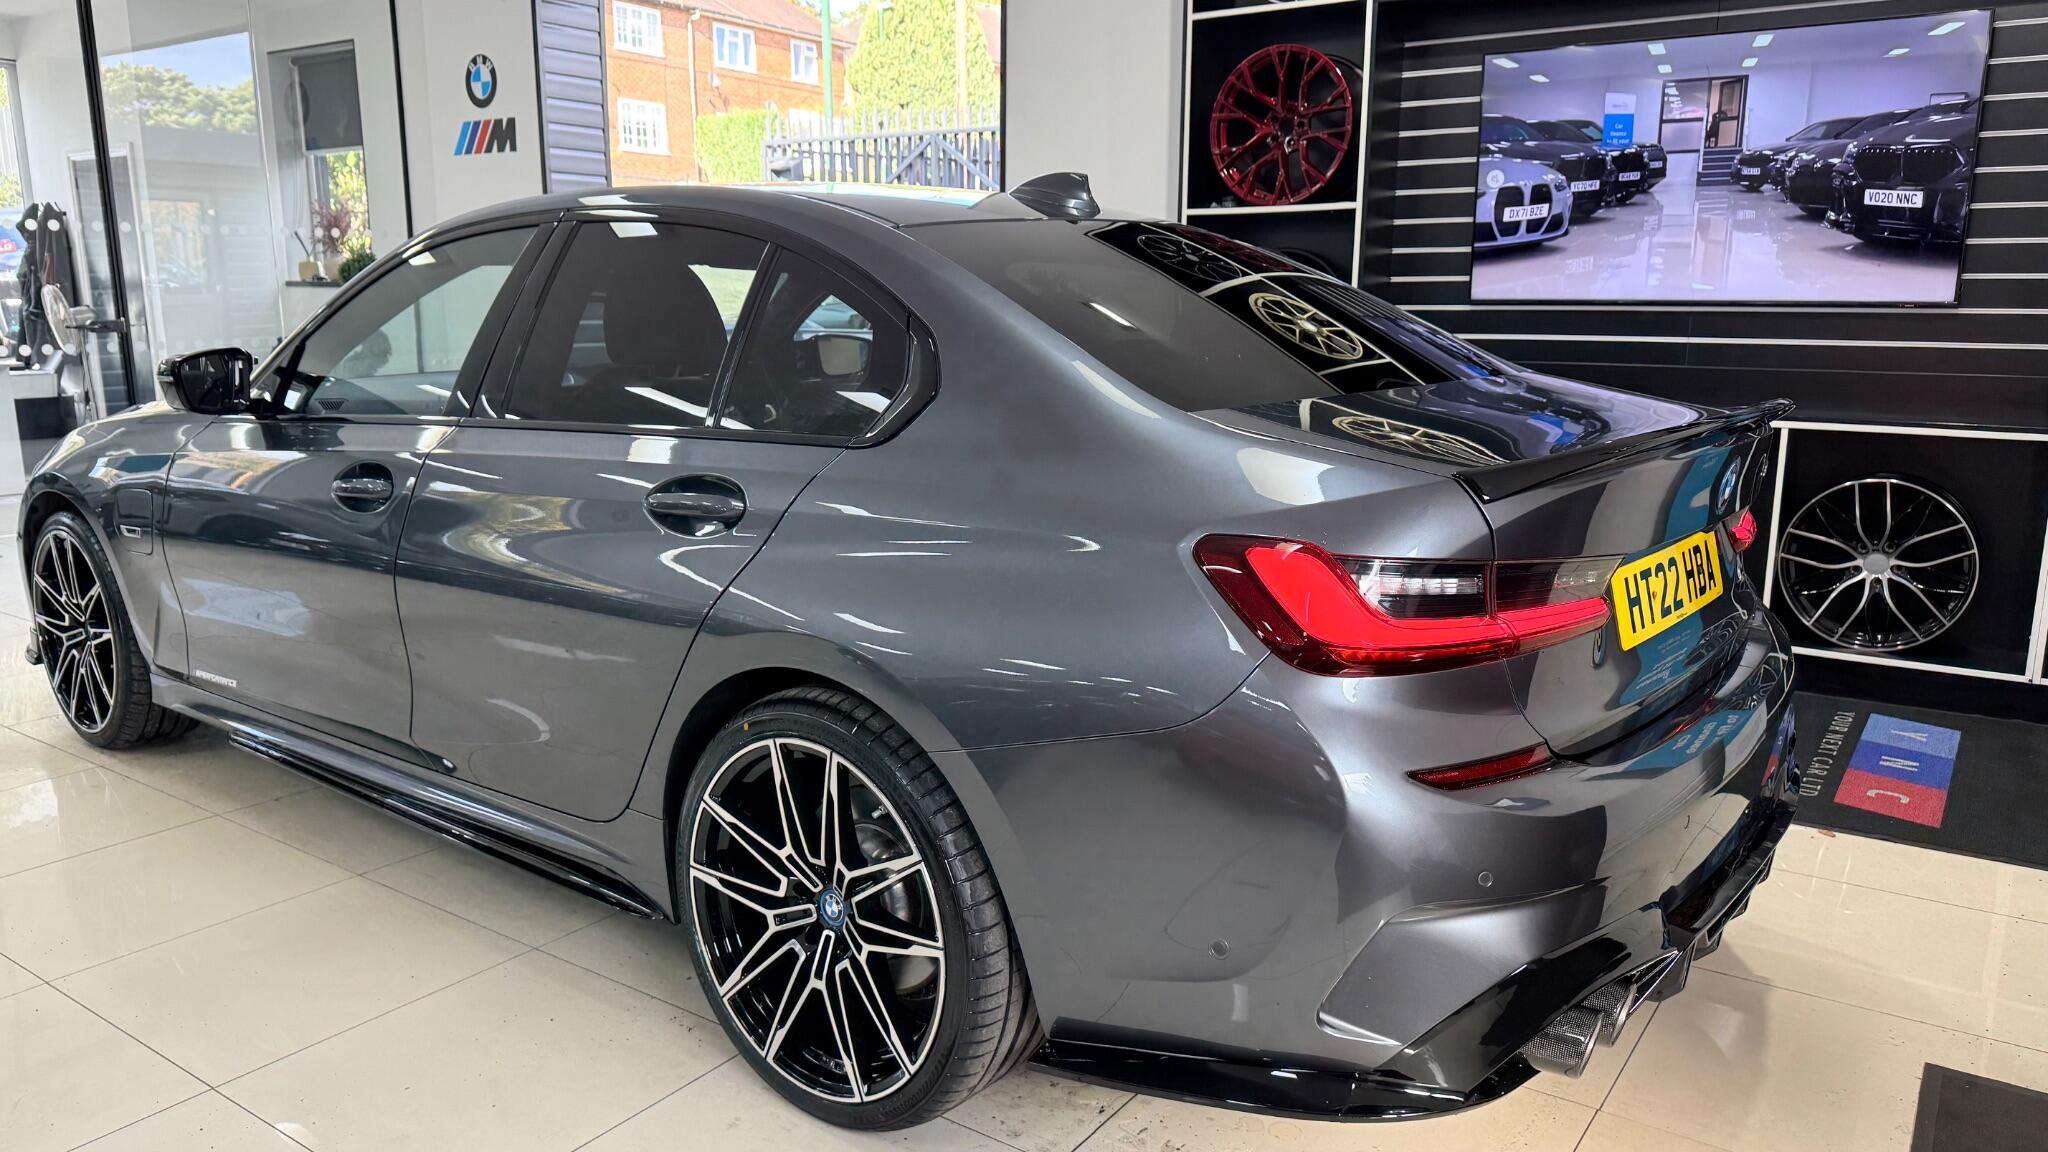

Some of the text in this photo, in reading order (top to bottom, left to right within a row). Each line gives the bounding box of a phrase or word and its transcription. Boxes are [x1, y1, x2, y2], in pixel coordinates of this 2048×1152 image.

[1508, 206, 1544, 219] DX71 BZE
[1896, 192, 1918, 205] NNC
[1624, 540, 1716, 634] HT22 HBA
[1799, 711, 1856, 797] YOUR NEXT CAR LTD
